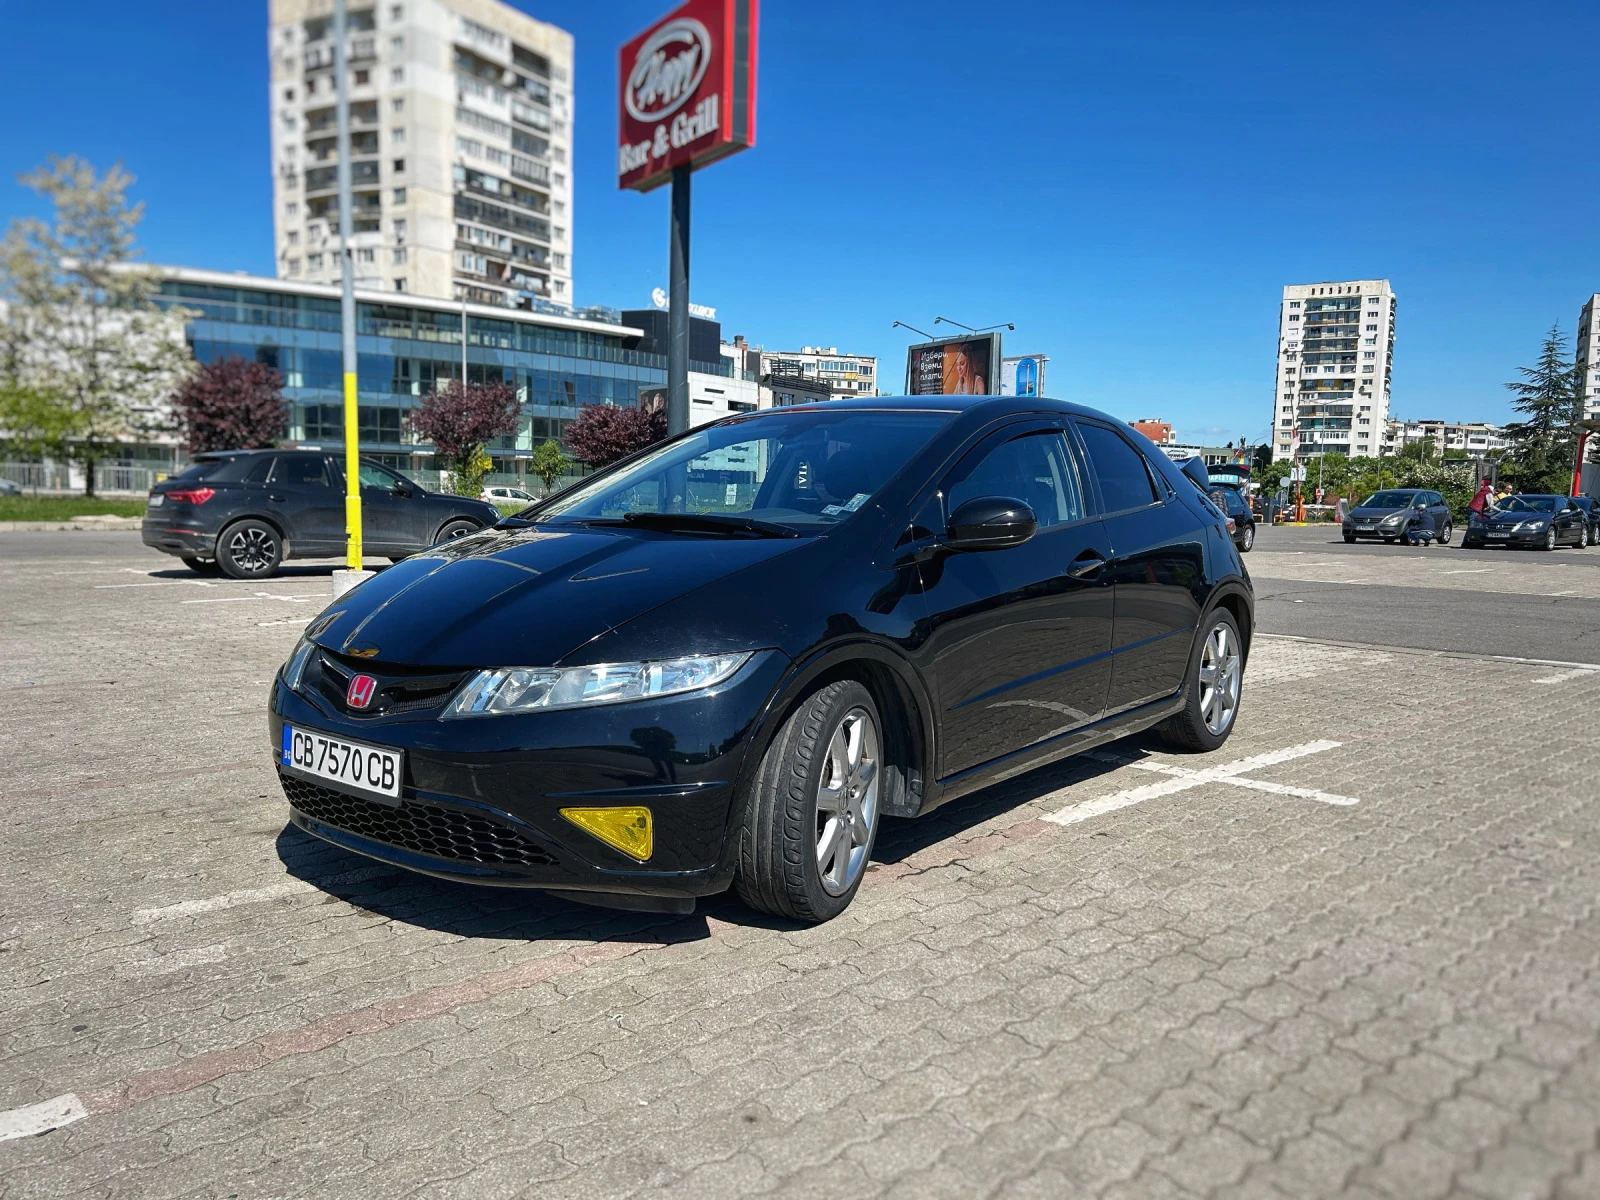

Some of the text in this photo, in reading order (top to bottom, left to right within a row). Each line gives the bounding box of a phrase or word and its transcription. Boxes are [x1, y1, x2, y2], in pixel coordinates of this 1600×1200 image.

[619, 93, 719, 175] Bar & Grill
[294, 732, 395, 791] CB 7570 CB
